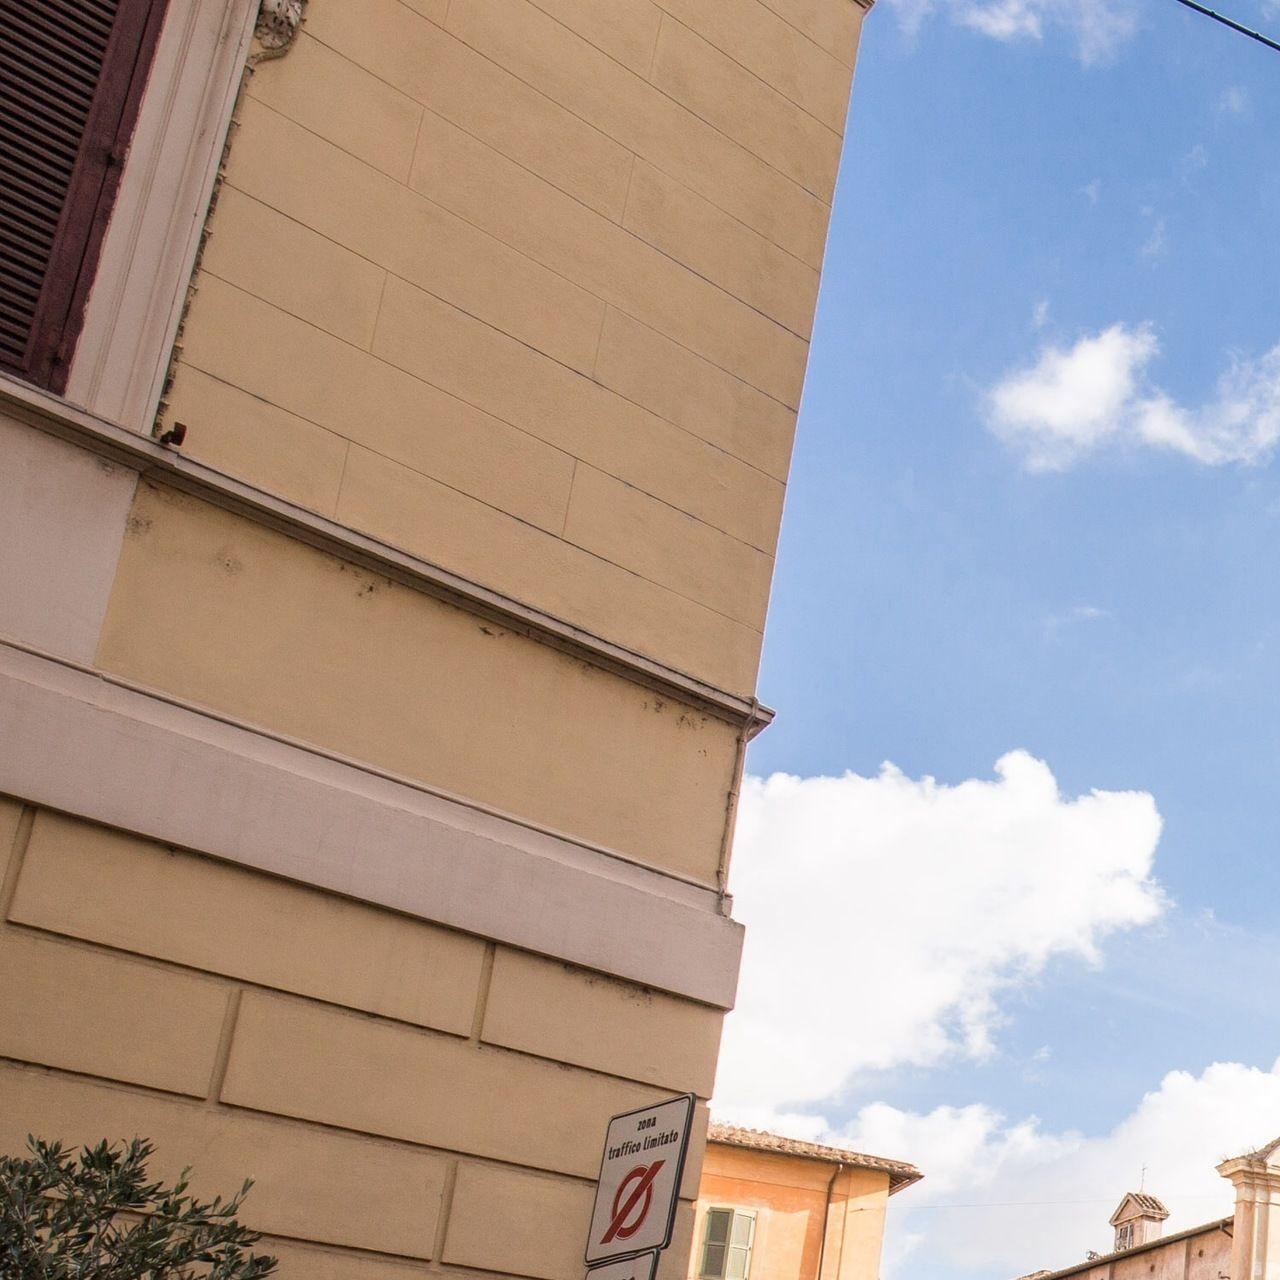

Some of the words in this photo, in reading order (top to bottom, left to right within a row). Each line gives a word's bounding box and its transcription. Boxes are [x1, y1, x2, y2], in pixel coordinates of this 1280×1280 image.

[637, 1116, 657, 1131] zona
[608, 1140, 642, 1160] traffico
[643, 1129, 679, 1151] limitato
